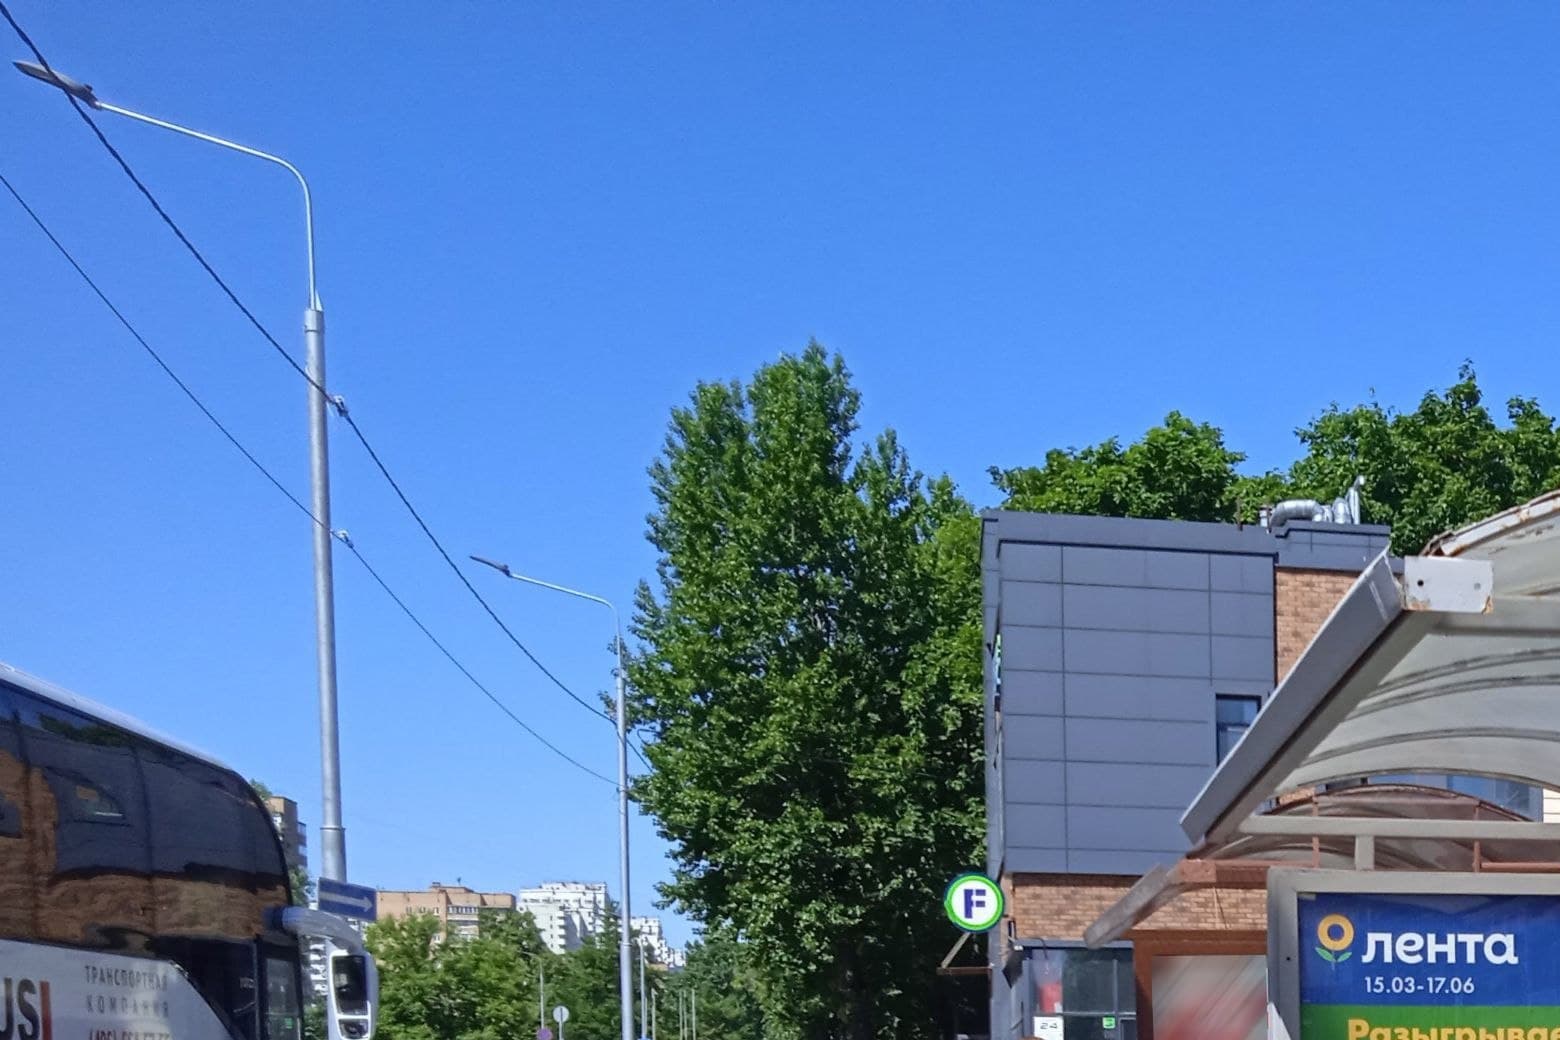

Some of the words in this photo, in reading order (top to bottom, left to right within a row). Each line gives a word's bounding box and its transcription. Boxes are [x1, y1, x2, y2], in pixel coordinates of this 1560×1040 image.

[963, 888, 986, 919] F
[1361, 931, 1519, 965] лента
[1364, 976, 1475, 994] 15.03-17.06
